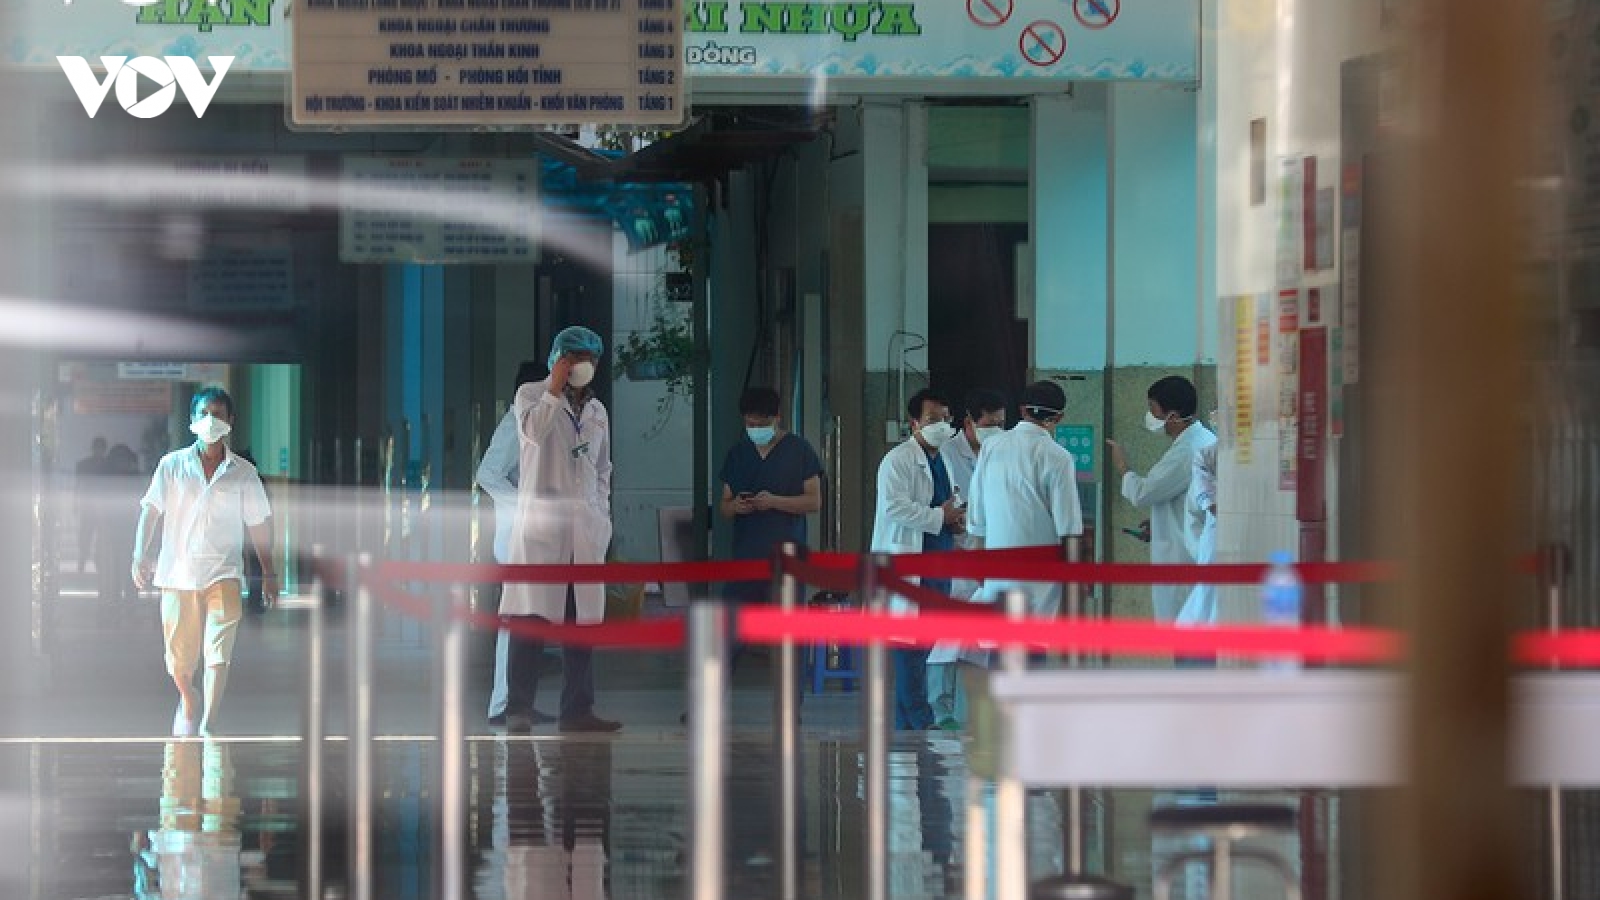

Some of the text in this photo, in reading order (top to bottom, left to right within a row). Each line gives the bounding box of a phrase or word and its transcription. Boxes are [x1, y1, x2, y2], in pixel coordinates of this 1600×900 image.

[740, 1, 922, 41] NHỰA
[389, 43, 425, 58] KHOA
[428, 43, 468, 61] NGOẠI
[509, 43, 541, 58] KINH
[669, 43, 675, 58] 3
[369, 67, 413, 85] PHÒNG
[460, 67, 503, 85] PHÒNG
[669, 70, 675, 84] 2
[669, 96, 675, 110] 1
